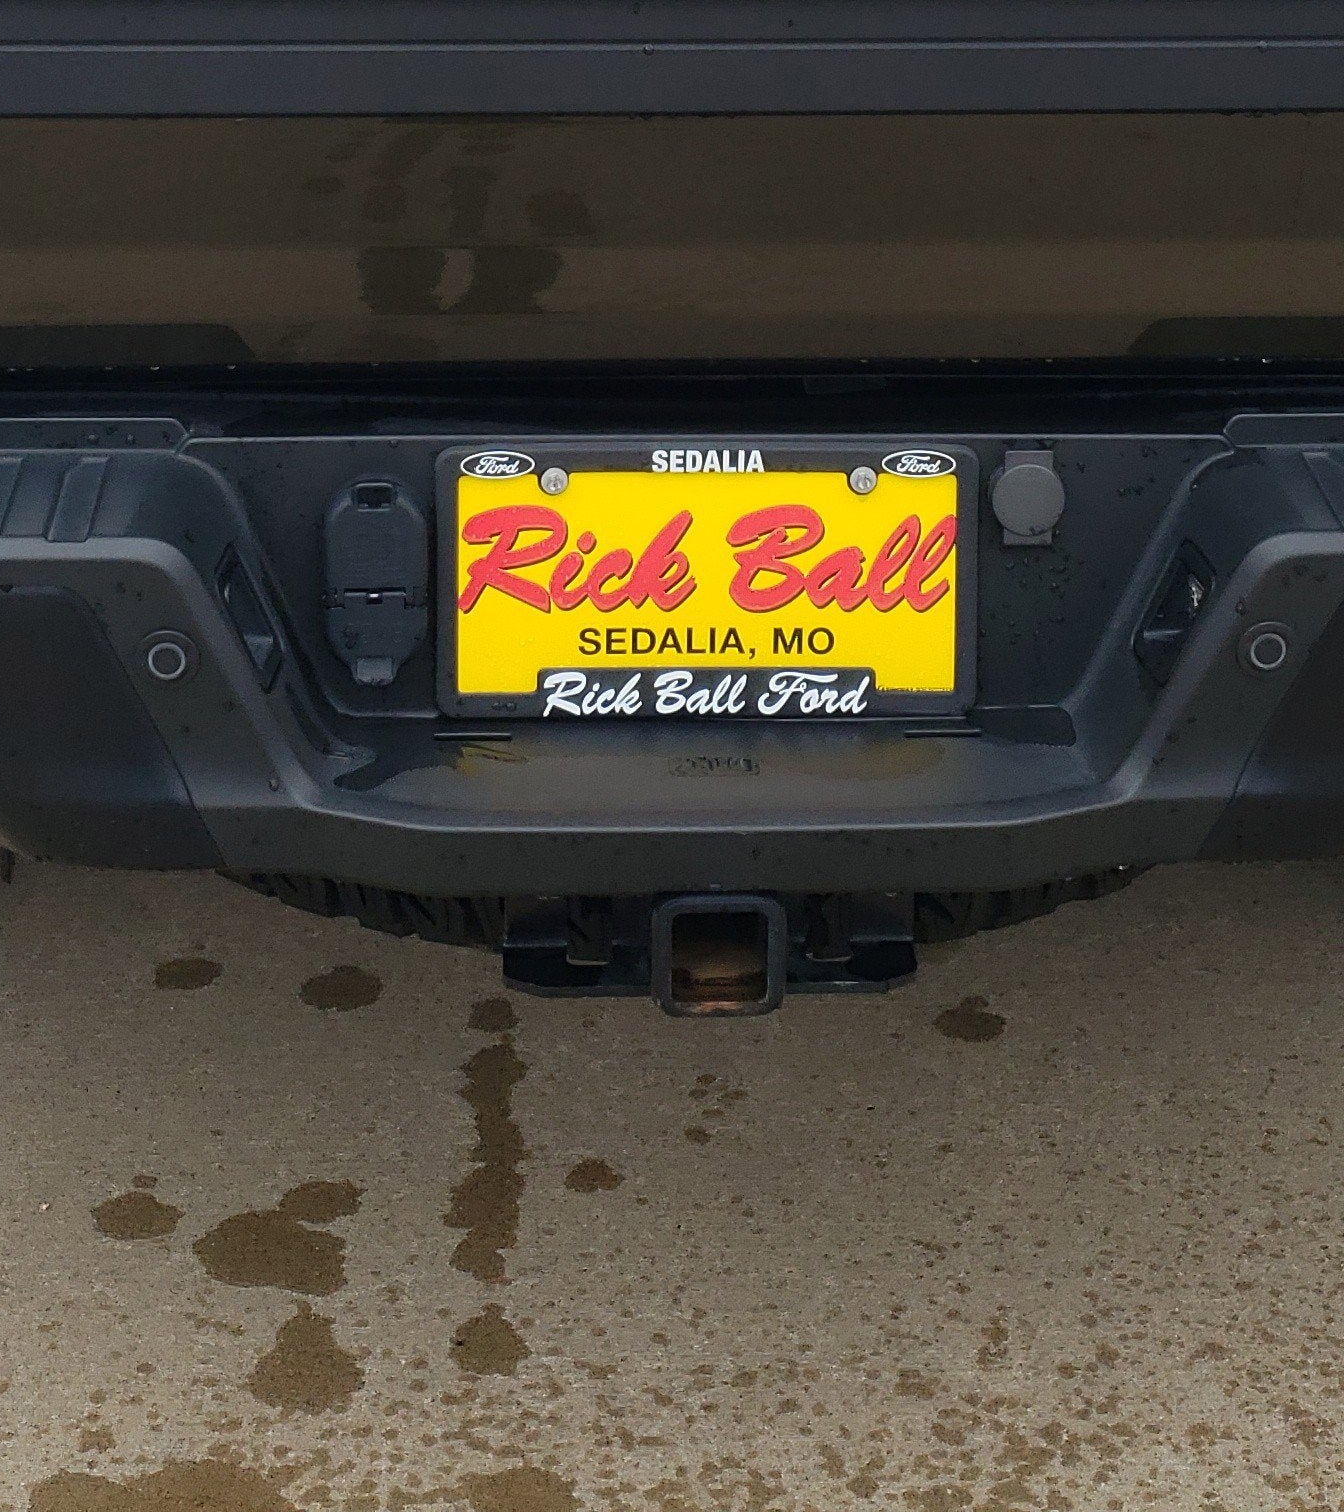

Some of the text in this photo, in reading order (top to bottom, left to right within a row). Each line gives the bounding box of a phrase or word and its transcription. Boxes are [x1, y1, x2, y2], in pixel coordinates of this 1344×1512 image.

[473, 456, 519, 475] Ford
[651, 449, 765, 473] SEDALIA
[896, 455, 941, 474] Ford
[458, 504, 956, 614] Rick Ball
[578, 627, 835, 659] SEDALIA, MO
[542, 671, 868, 717] Rick Ball Ford
